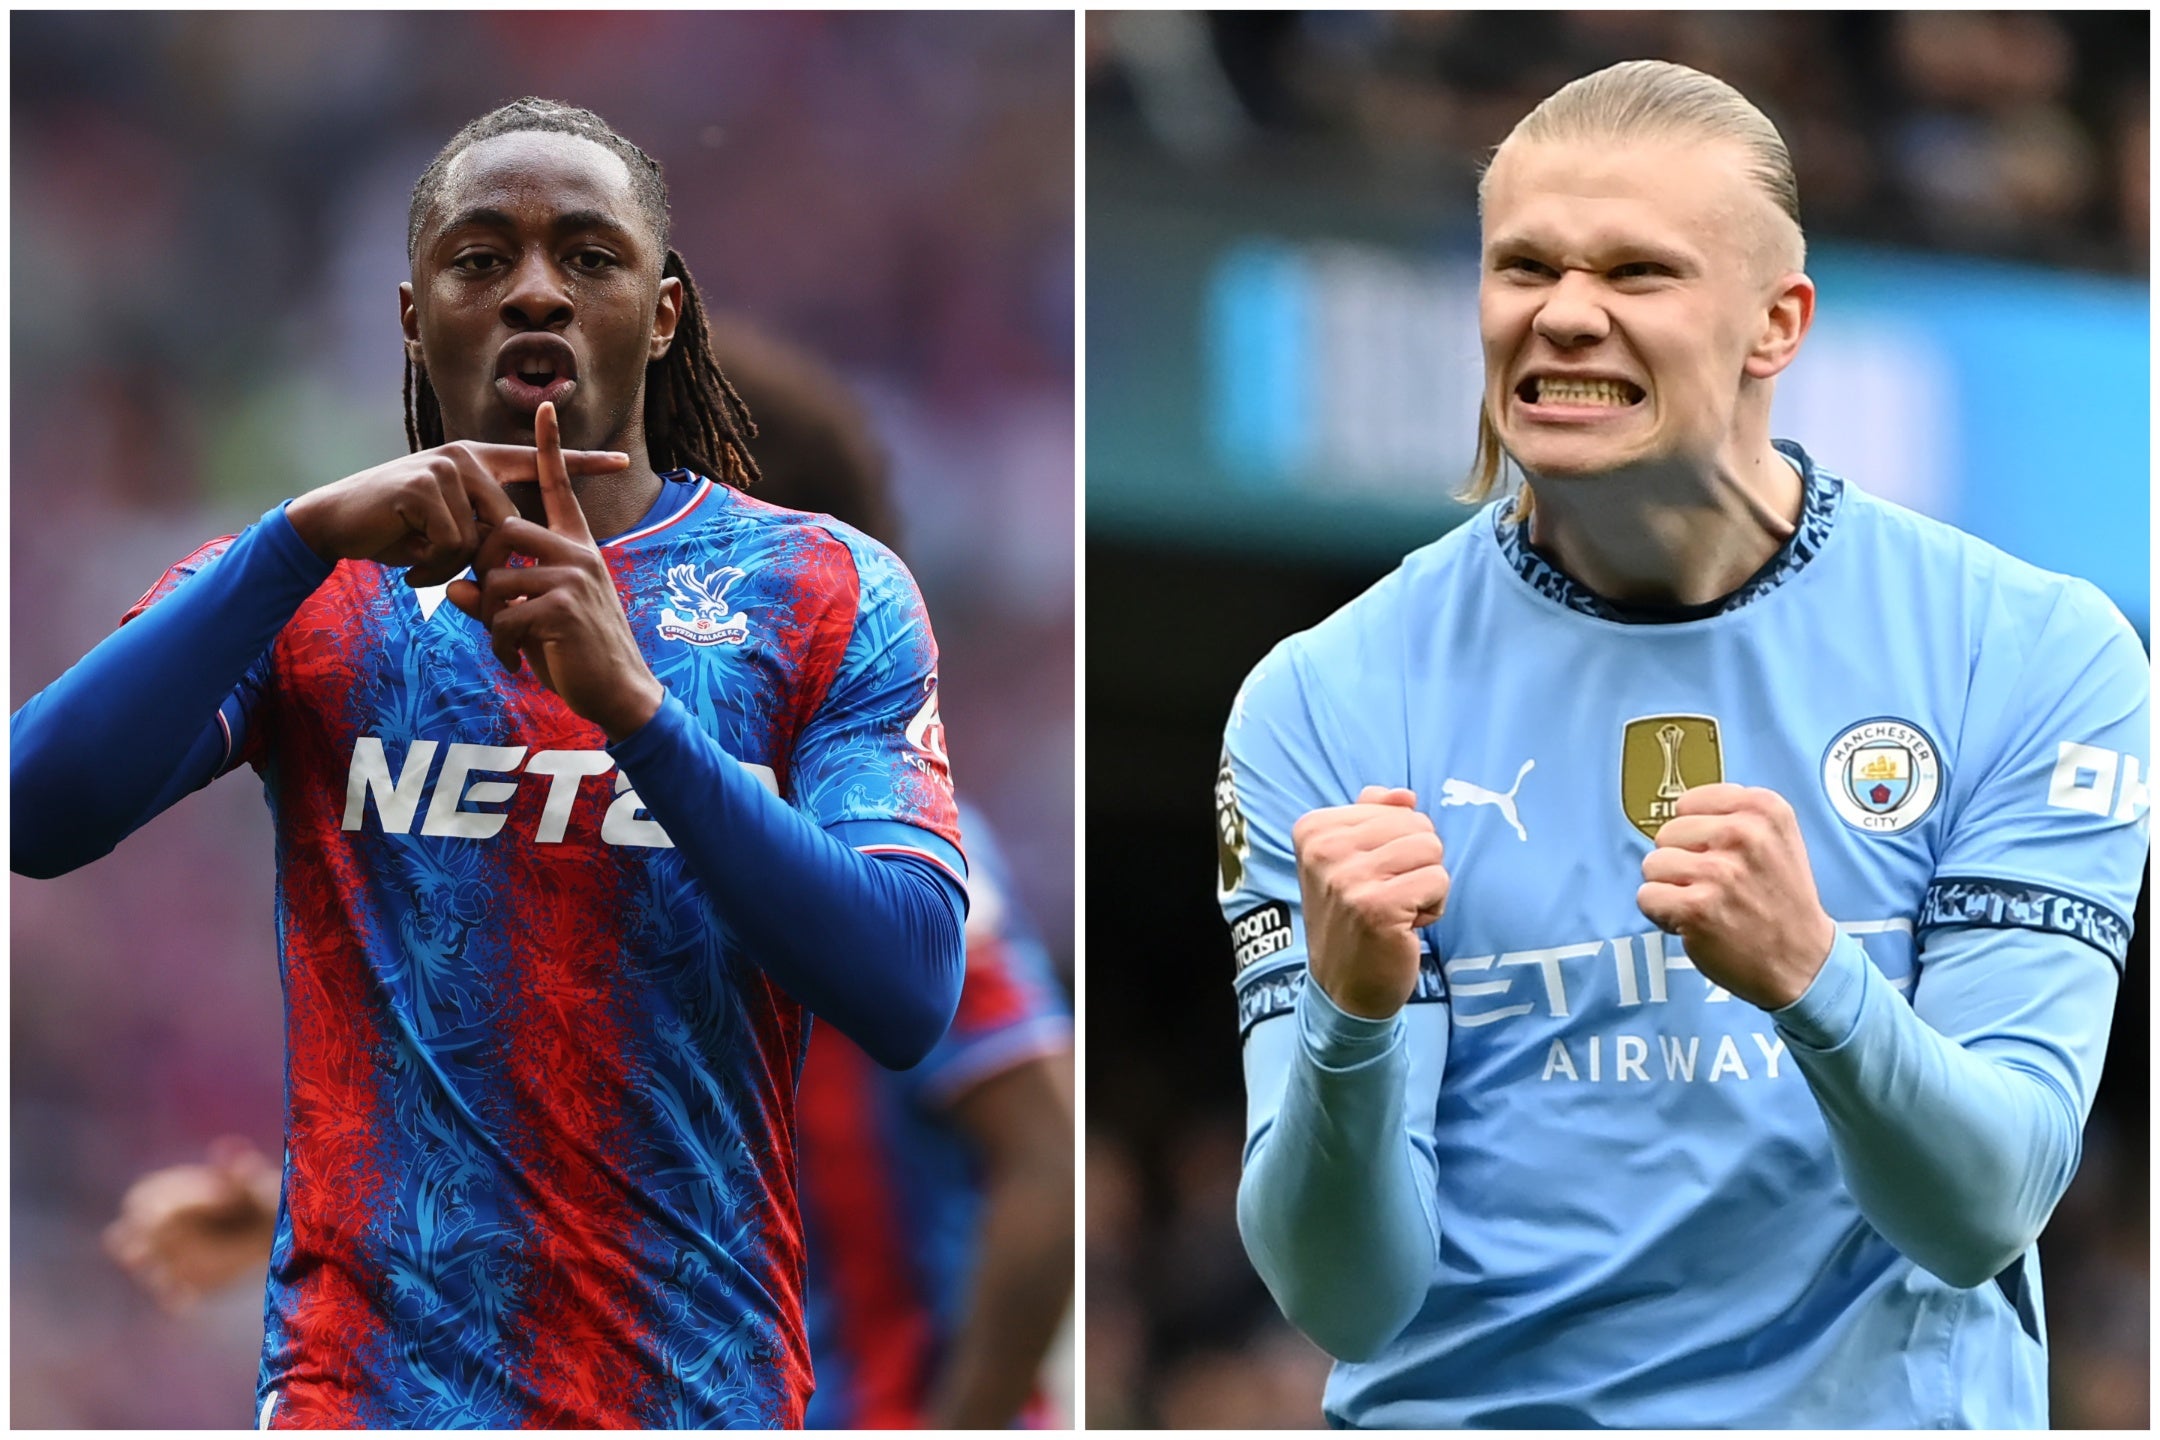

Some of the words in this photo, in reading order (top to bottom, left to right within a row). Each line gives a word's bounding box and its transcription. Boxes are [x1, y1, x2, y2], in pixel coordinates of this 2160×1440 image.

[665, 626, 697, 641] CRYSTAL
[697, 630, 727, 642] PALACE
[727, 629, 741, 637] F.C.
[1833, 726, 1930, 762] MANCHESTER
[1863, 817, 1898, 828] CITY
